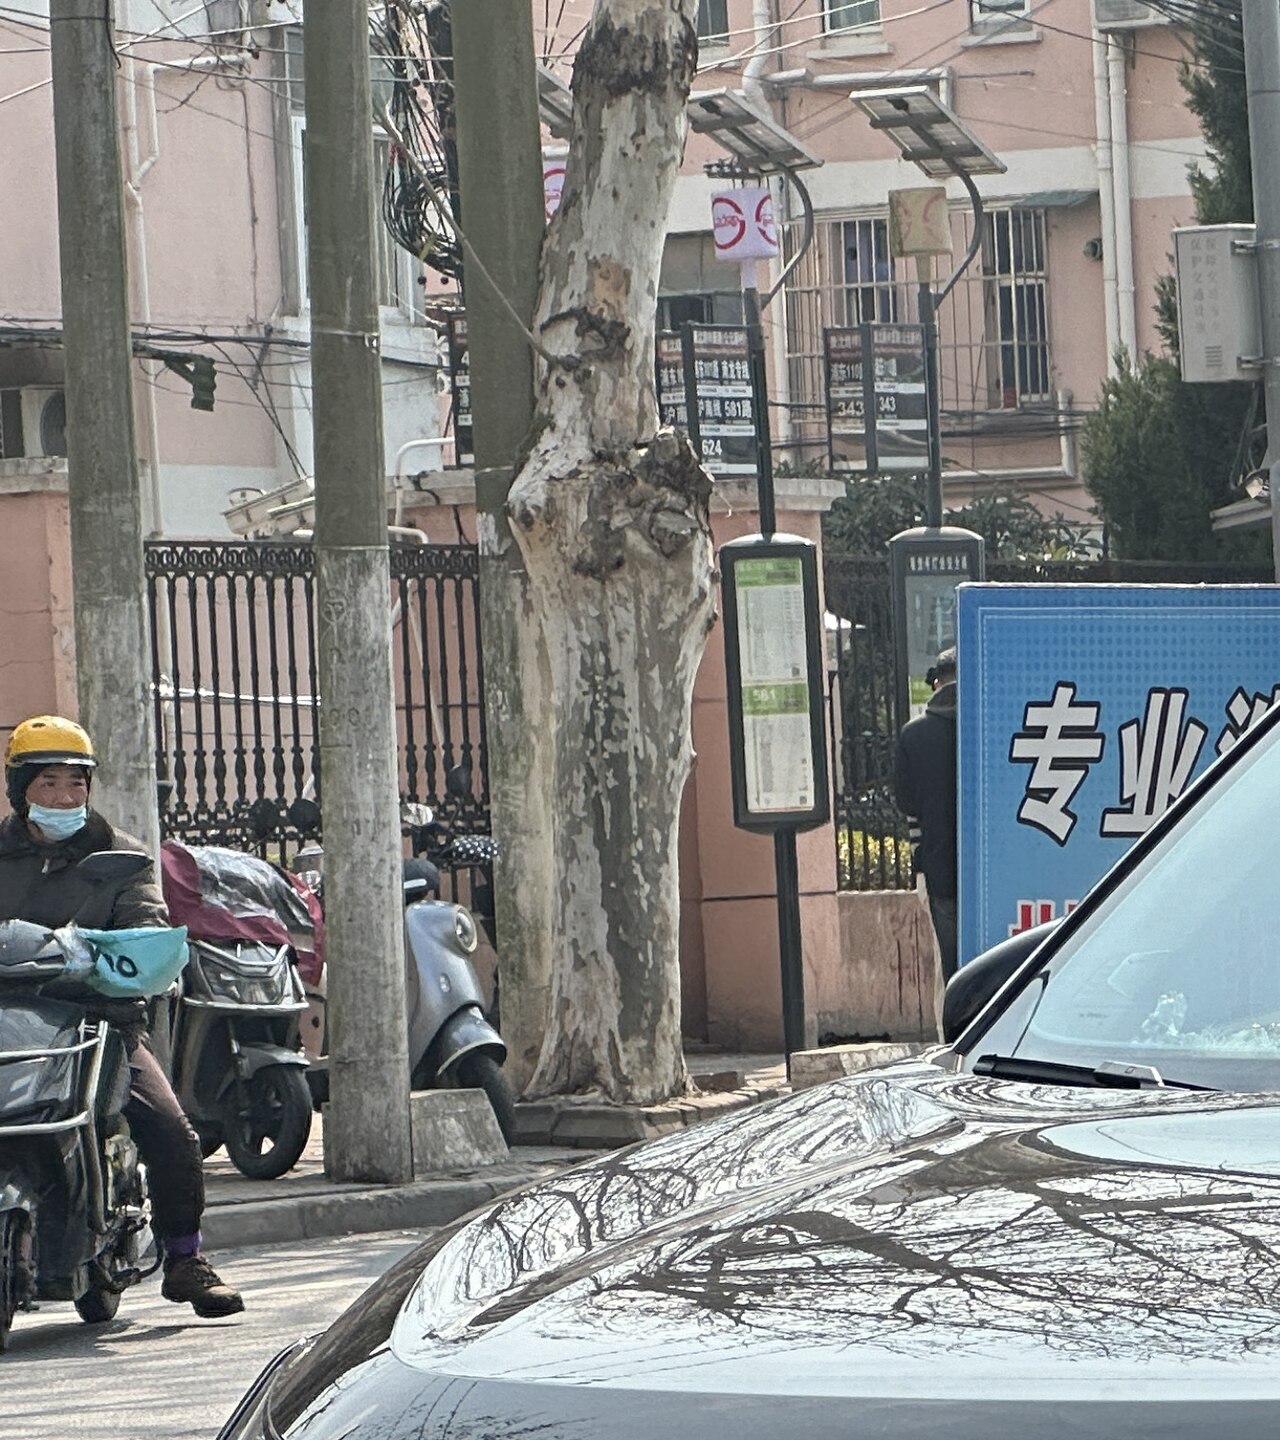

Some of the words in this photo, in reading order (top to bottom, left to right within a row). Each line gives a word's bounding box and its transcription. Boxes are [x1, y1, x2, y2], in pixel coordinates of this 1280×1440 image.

[838, 401, 864, 417] 343
[879, 396, 897, 412] 343
[702, 439, 722, 455] 624
